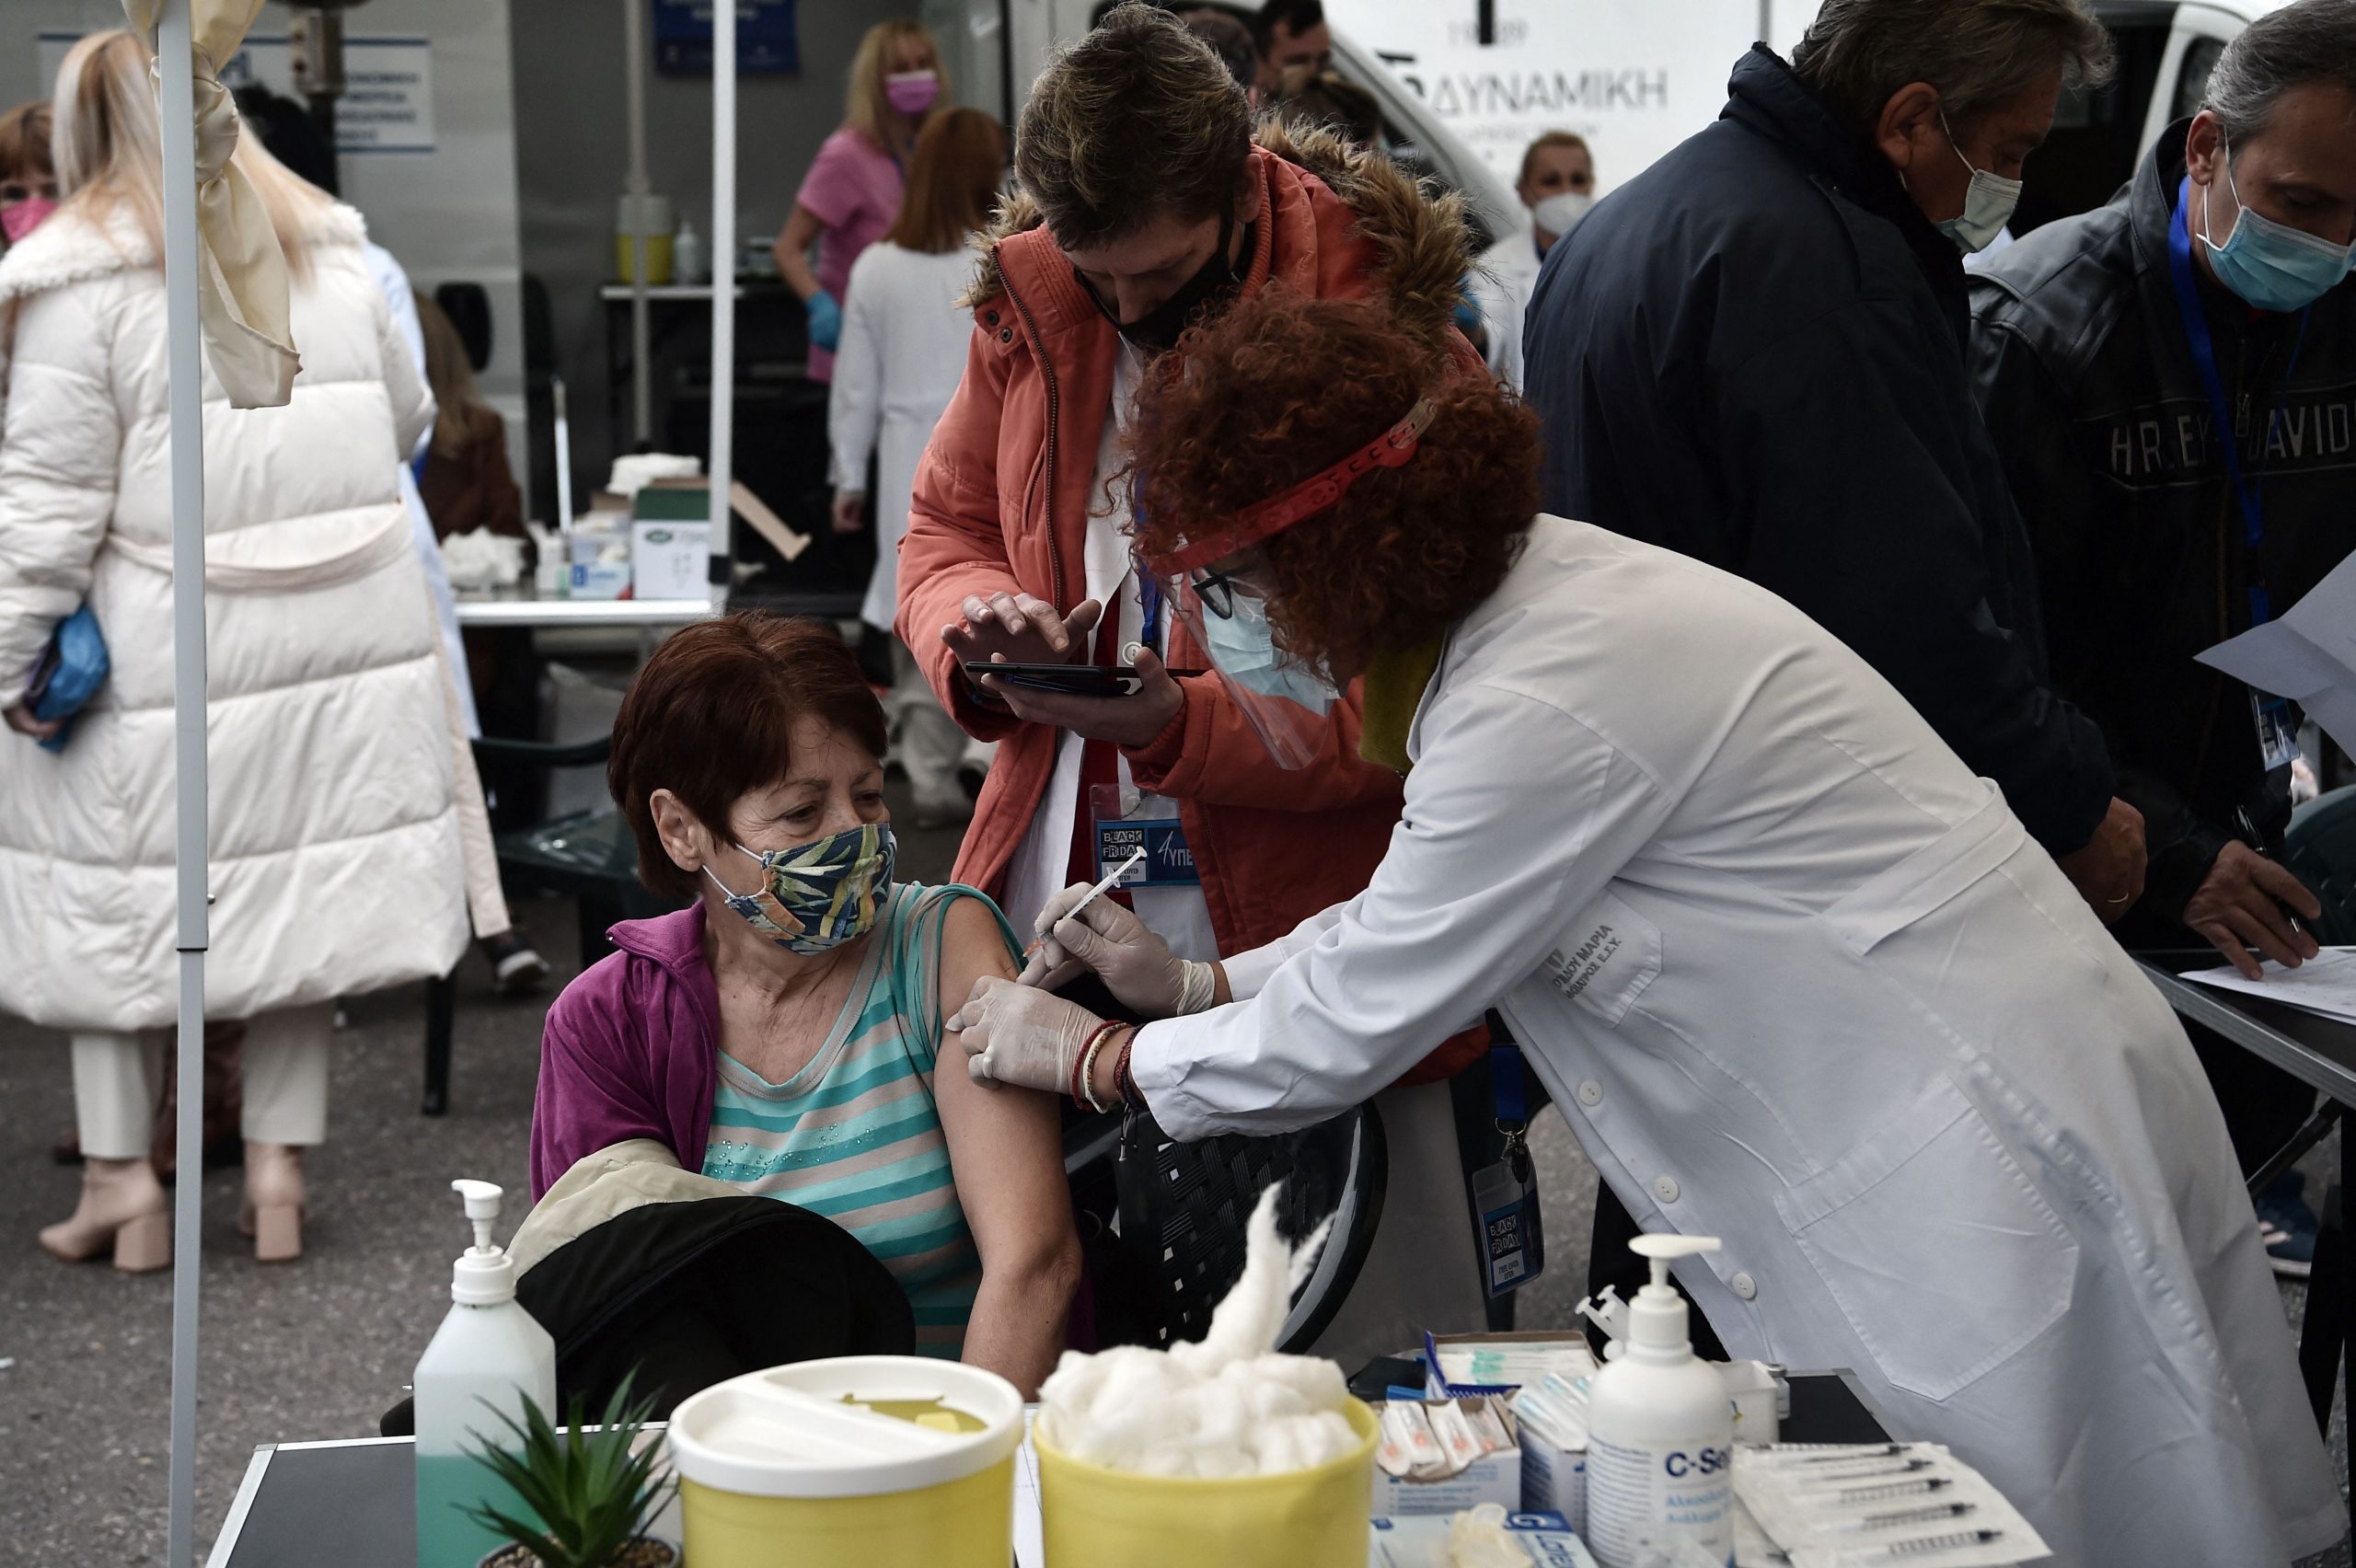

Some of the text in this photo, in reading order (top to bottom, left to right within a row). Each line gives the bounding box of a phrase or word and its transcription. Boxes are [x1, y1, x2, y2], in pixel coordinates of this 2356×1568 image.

[1103, 830, 1142, 843] BLACK
[1103, 844, 1138, 858] FRIDA
[1576, 924, 1613, 962] ΜΑΡΙΑ
